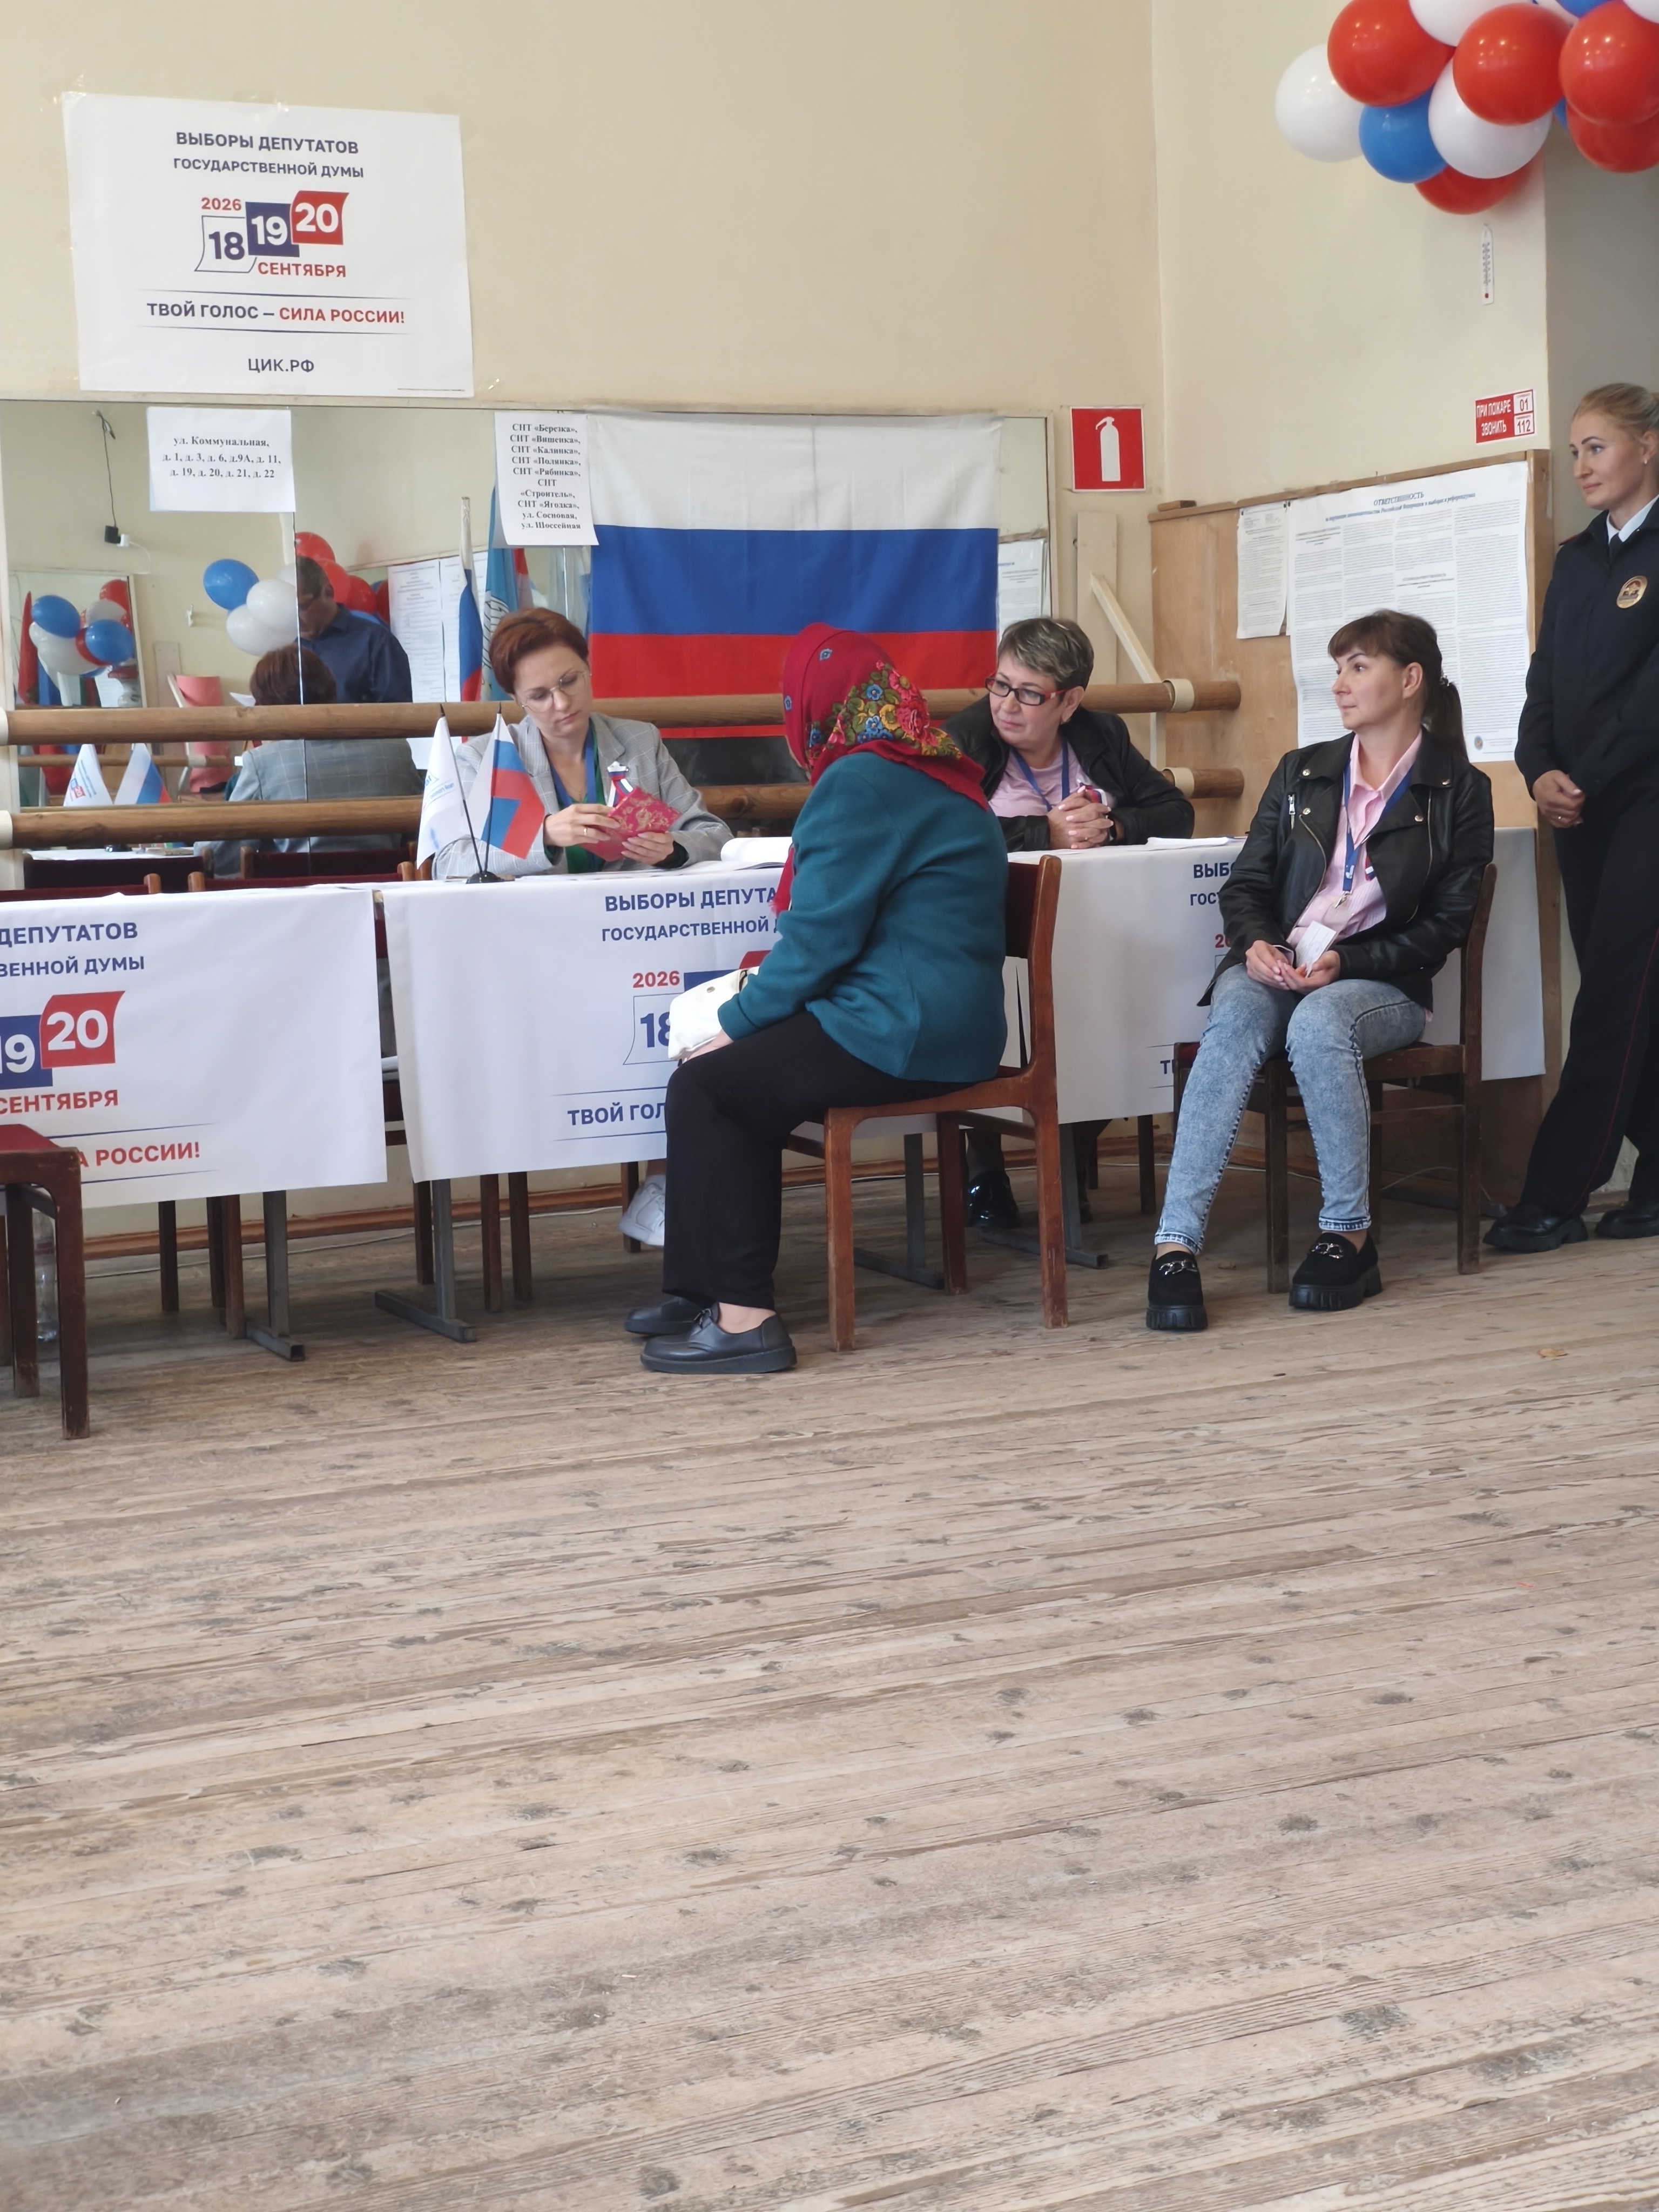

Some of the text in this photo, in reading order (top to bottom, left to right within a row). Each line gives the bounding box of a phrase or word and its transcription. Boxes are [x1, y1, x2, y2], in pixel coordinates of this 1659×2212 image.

[176, 132, 359, 154] ВЫБОРЫ ДЕПУТАТОВ
[173, 158, 364, 179] ГОСУДАРСТВЕННОЙ ДУМЫ
[201, 197, 241, 211] 2026
[208, 202, 339, 260] 18 19 20
[258, 262, 346, 278] СЕНТЯБРЯ
[147, 300, 195, 318] ТВОЙ
[200, 305, 259, 319] ГОЛОС
[279, 307, 326, 321] СИЛА
[331, 309, 404, 324] РОССИИ!
[248, 358, 314, 373] ЦИК.РФ
[1476, 400, 1511, 418] ПРИ ПОЖАРЕ
[1520, 397, 1528, 412] 01
[1481, 420, 1507, 436] ЗВОНИТЬ
[1518, 420, 1530, 433] 112
[174, 436, 269, 448] ул. Коммунальная,
[510, 434, 530, 442] СНТ
[511, 445, 530, 453] СНТ
[175, 453, 183, 462] 1,
[196, 453, 205, 462] 3,
[218, 454, 227, 462] 6,
[268, 455, 281, 464] 11,
[512, 456, 531, 464] СНТ
[183, 468, 195, 477] 19,
[209, 468, 223, 477] 20,
[237, 469, 251, 478] 21,
[264, 469, 275, 478] 22
[538, 478, 557, 487] СНТ
[1193, 862, 1235, 879] ВЫБ
[605, 887, 776, 912] ВЫБОРЫ ДЕПУТА
[0, 922, 138, 948] ДЕПУТАТОВ
[602, 916, 769, 941] ГОСУДАРСТВЕННОЙ
[84, 956, 145, 975] ДУМЫ
[632, 970, 680, 988] 2026
[0, 1009, 109, 1074] 9 20
[568, 1102, 666, 1126] ТВОЙ ГОЛ
[96, 1142, 200, 1166] РОССИИ!
